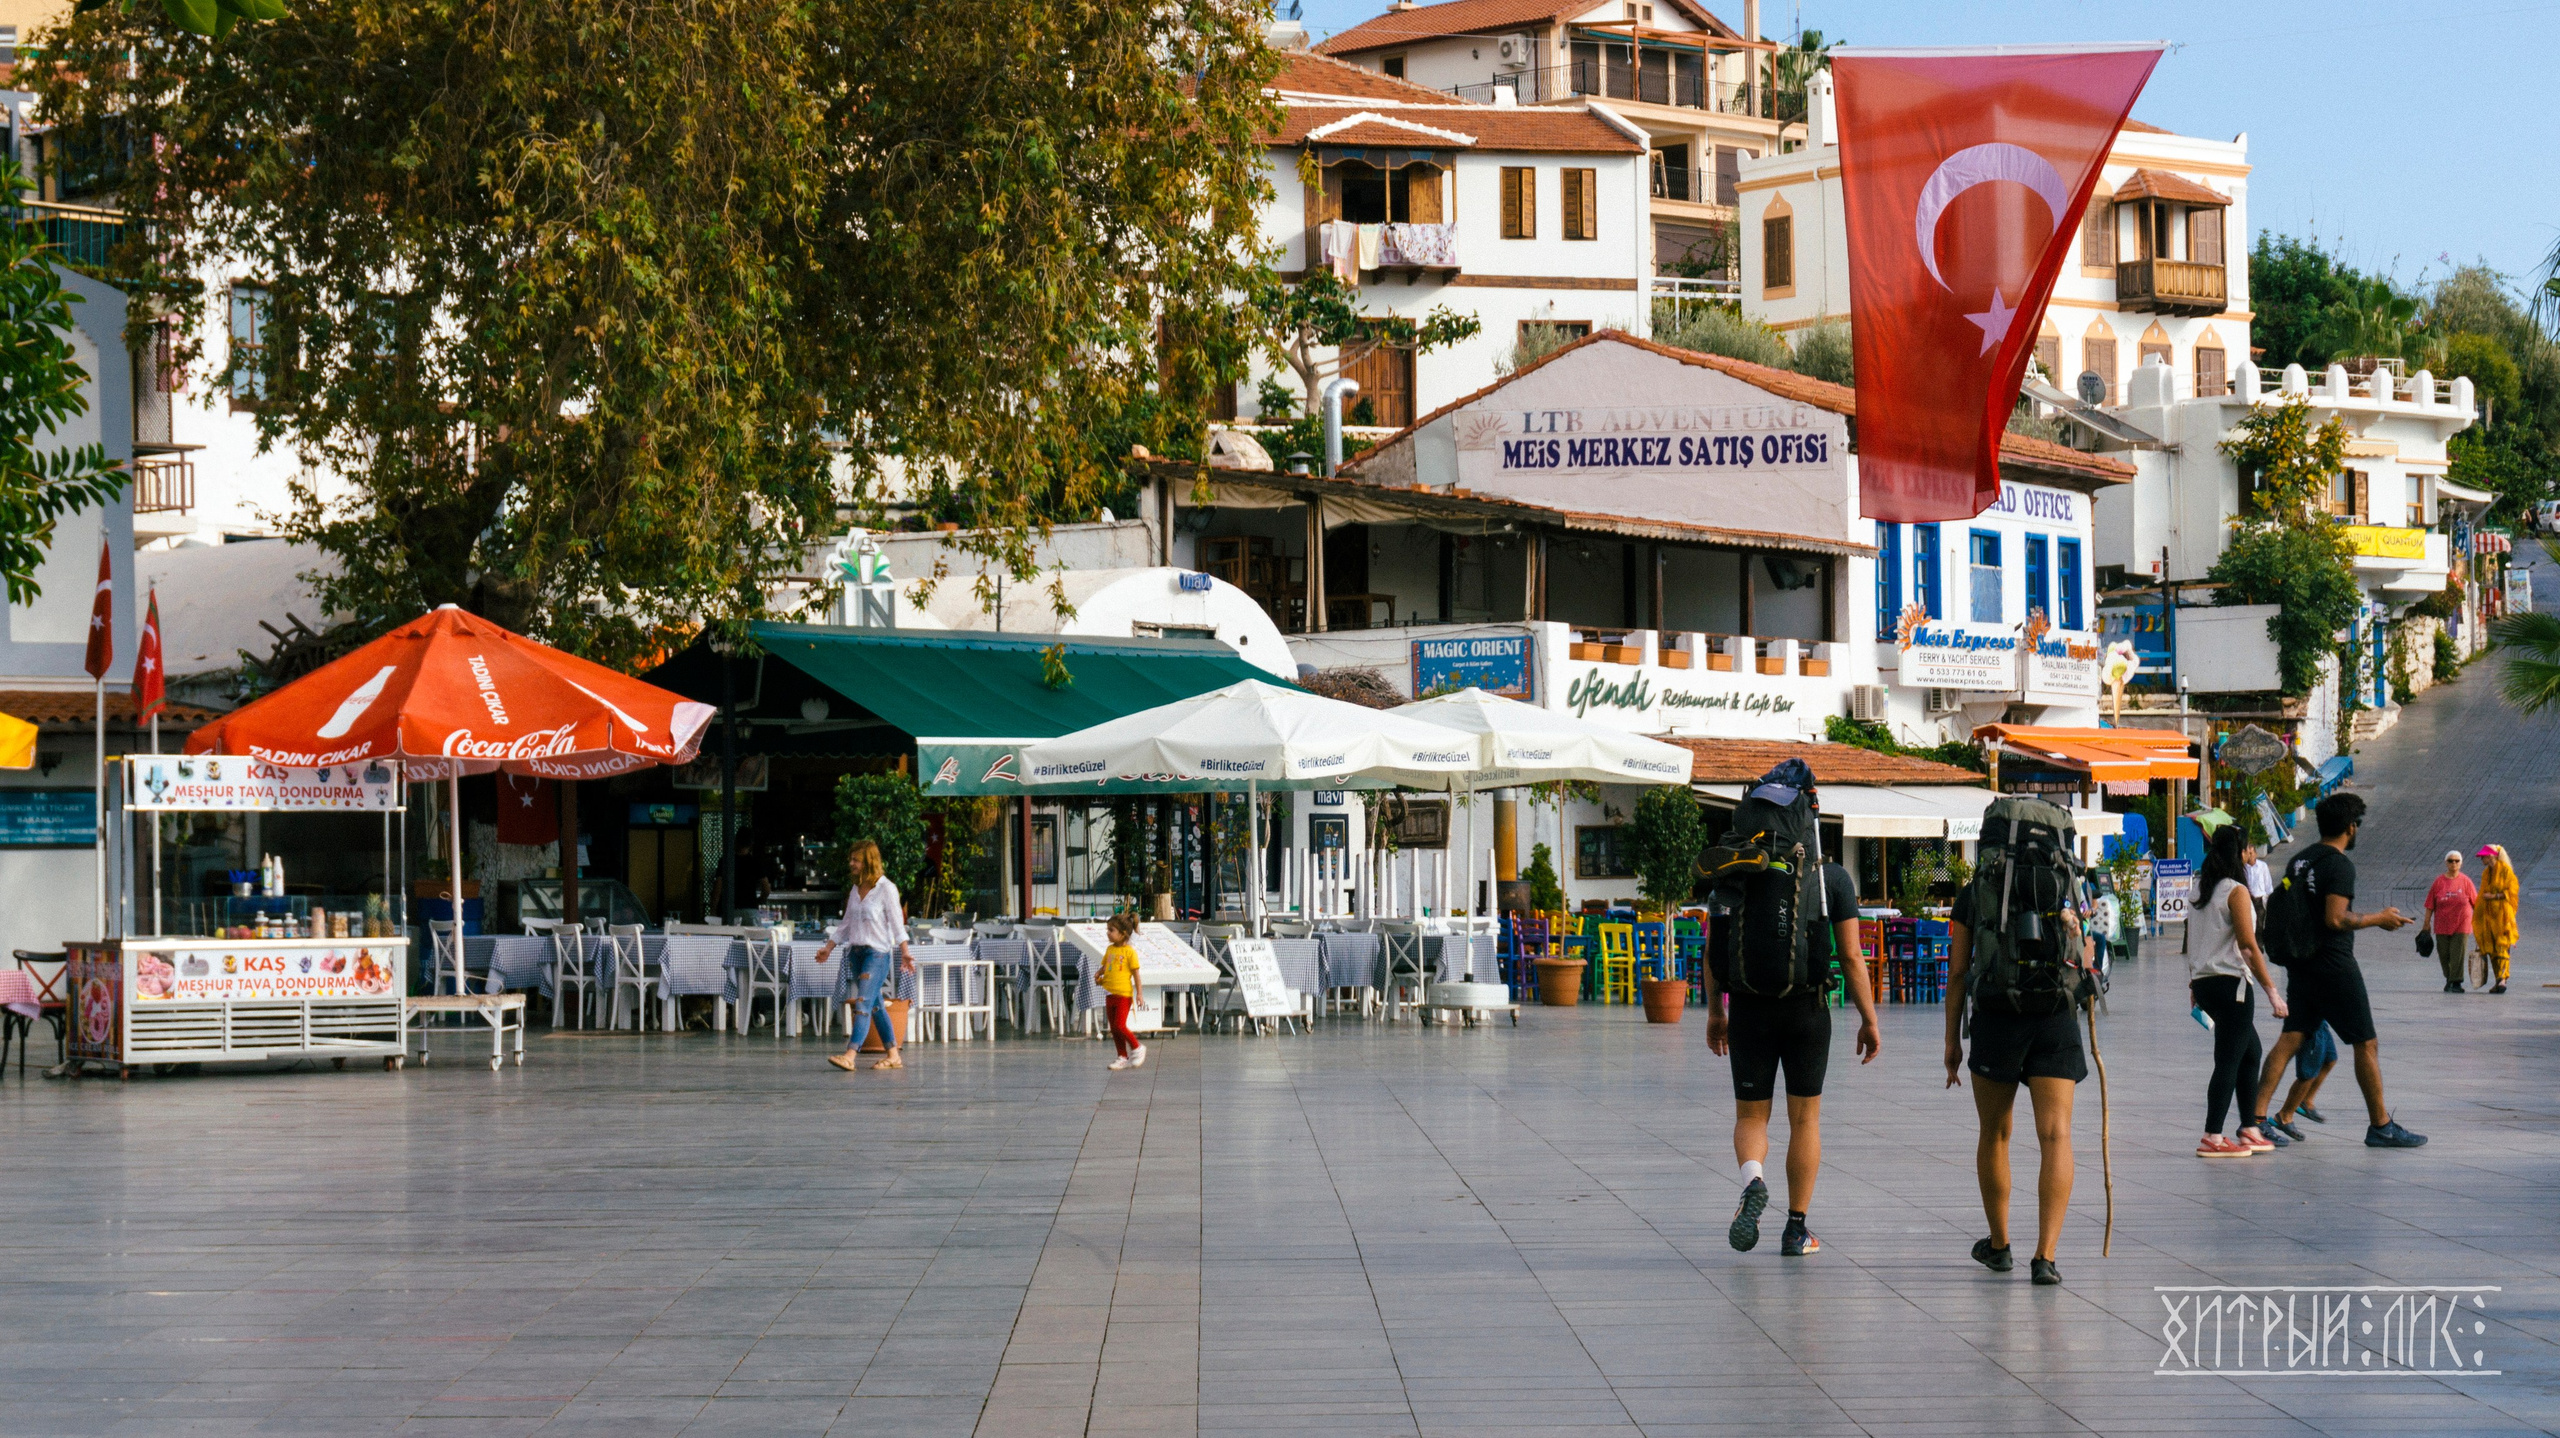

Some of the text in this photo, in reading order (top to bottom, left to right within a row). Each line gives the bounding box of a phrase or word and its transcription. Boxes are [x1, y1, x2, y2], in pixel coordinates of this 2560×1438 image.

[1522, 405, 1808, 433] LTB ADVENTURE
[1567, 437, 1672, 467] MERKEZ
[1678, 435, 1754, 469] SATIŞ
[2024, 488, 2073, 521] OFFICE
[2382, 535, 2423, 547] QUANTUM
[1912, 626, 2016, 652] Meis Express
[1424, 640, 1522, 658] MAGIC ORIENT
[1919, 652, 2000, 665] FERRY & YACHT SERVICES
[467, 655, 510, 725] TADINI ÇIKAR
[1916, 676, 2003, 687] www.meisexpress.com
[1567, 667, 1796, 719] efendi Restaurant & Cafe Bar
[442, 721, 578, 760] Coca-Cola
[249, 741, 372, 767] TADINI ÇIKAR
[1298, 753, 1346, 769] #BirlikteGüzel
[1411, 751, 1471, 763] #BirlikteGüzel
[247, 764, 290, 784] KAŞ
[1033, 760, 1106, 776] #BirlikteGüzel
[1200, 759, 1266, 772] #BirlikteGüzel
[1622, 758, 1681, 774] #BirlikteGüzel
[175, 785, 364, 799] MEŞHUR TAVA DONDURMA
[1316, 790, 1343, 803] mavi
[1952, 820, 1979, 838] efendi
[2161, 899, 2184, 911] 60
[243, 956, 286, 975] KAŞ
[238, 979, 272, 990] TAVA
[276, 977, 356, 990] DONDURMA
